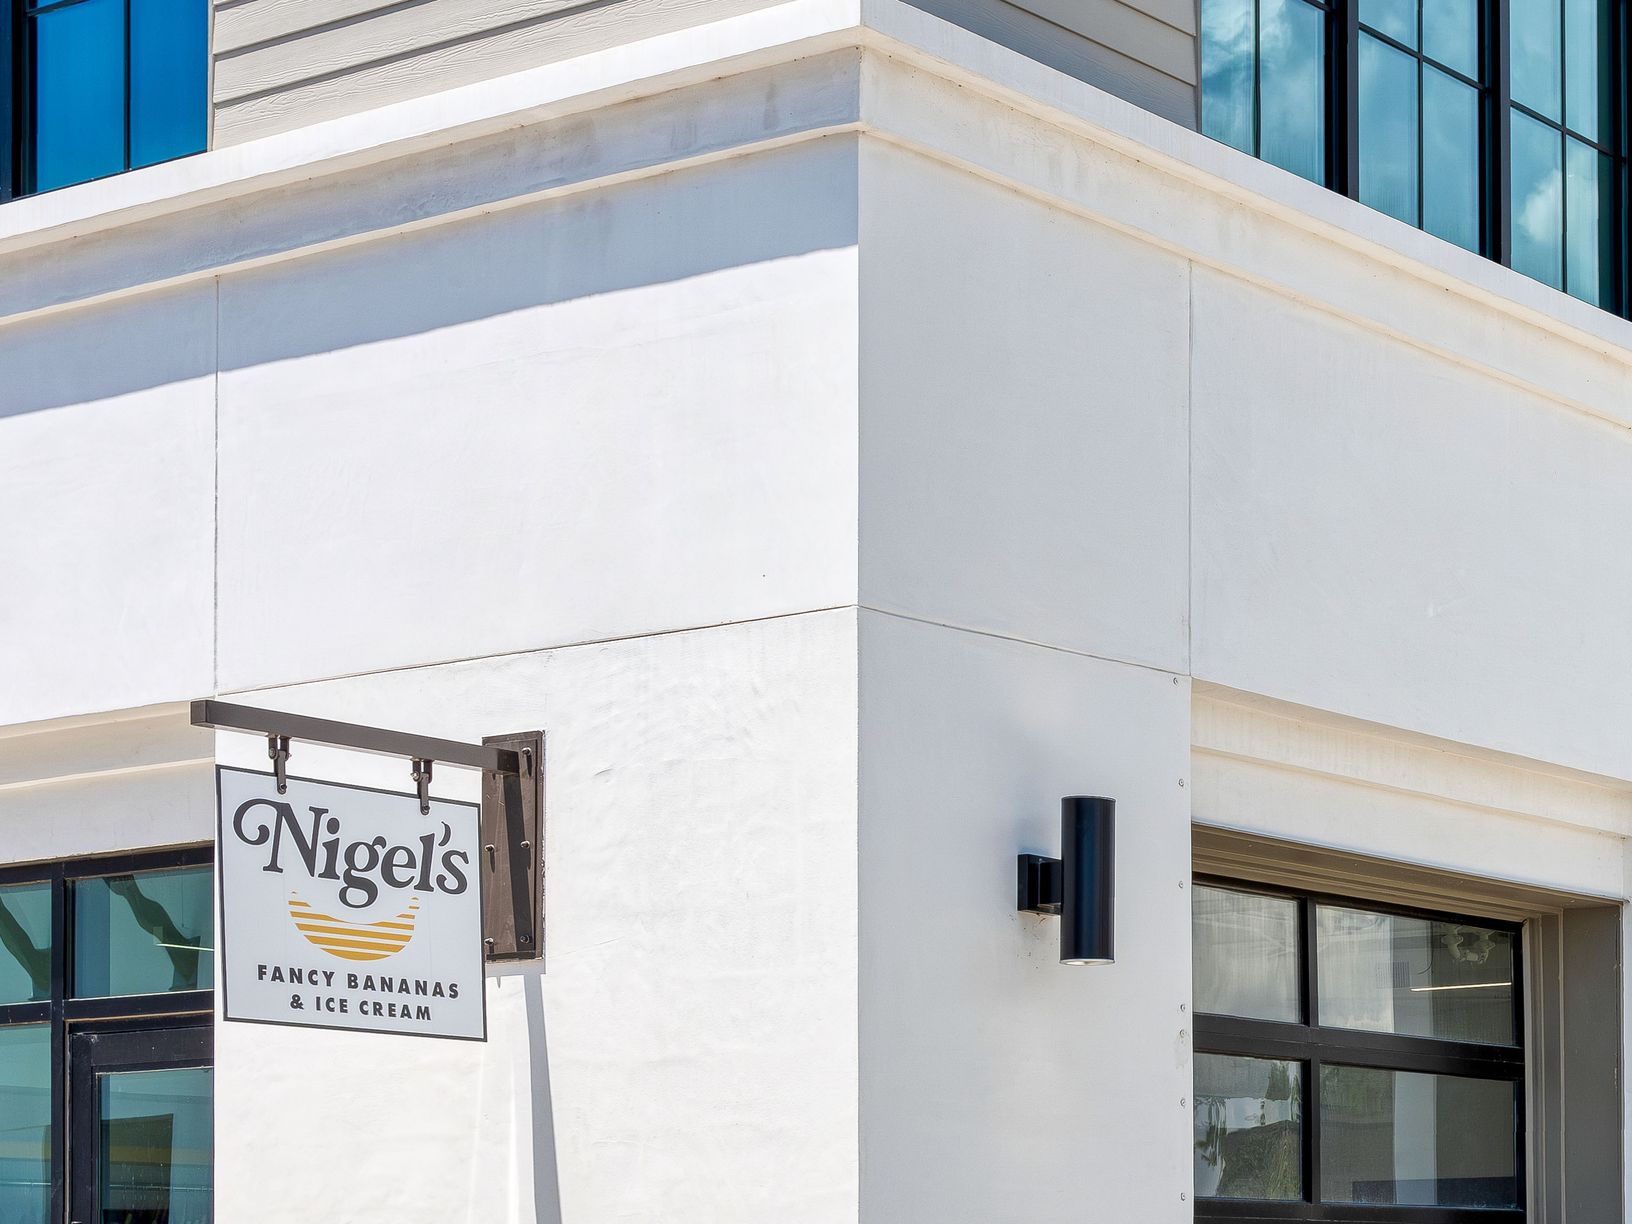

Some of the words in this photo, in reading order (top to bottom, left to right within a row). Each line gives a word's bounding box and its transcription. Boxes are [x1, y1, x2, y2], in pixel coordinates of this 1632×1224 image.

[232, 798, 470, 909] Nigel's
[257, 964, 335, 987] FANCY
[347, 973, 459, 999] BANANAS
[290, 993, 305, 1010] &
[315, 996, 349, 1014] ICE
[359, 1001, 432, 1021] CREAM
